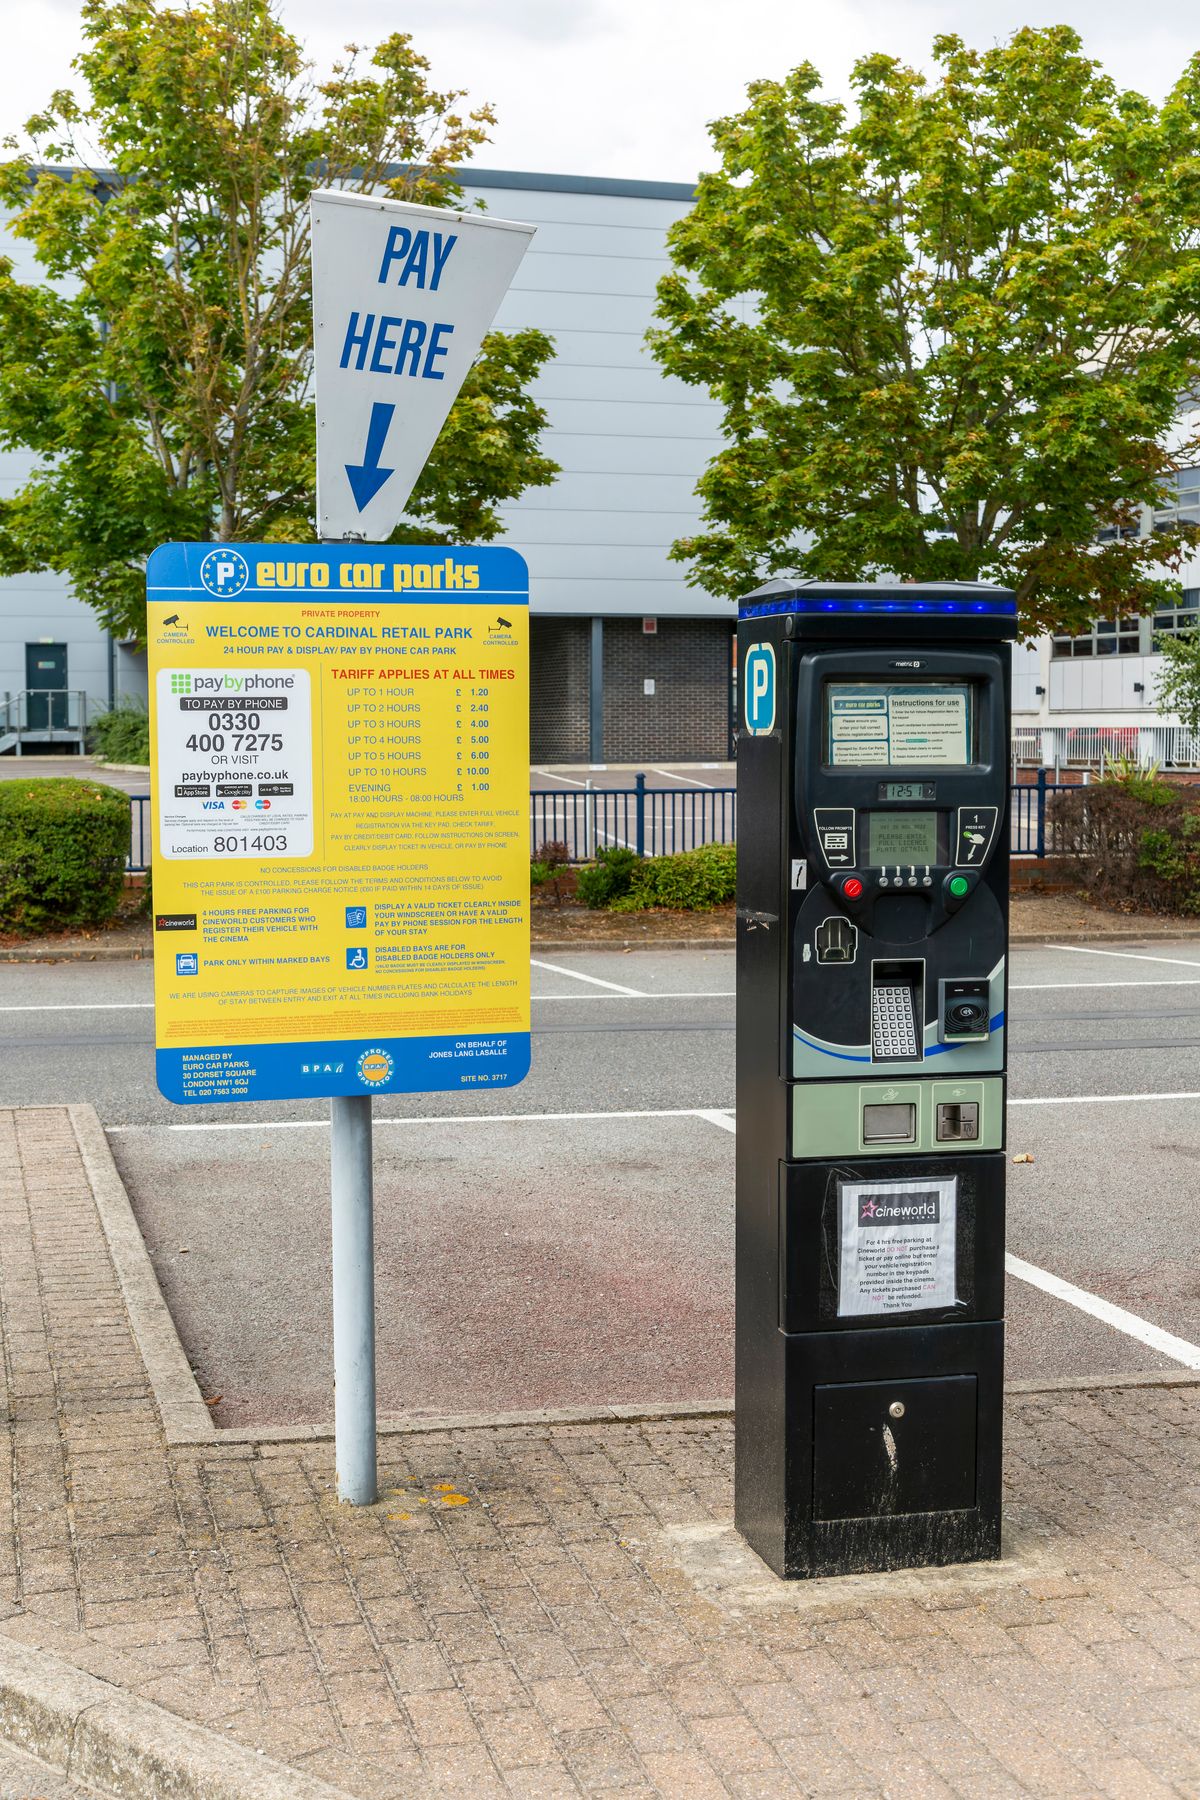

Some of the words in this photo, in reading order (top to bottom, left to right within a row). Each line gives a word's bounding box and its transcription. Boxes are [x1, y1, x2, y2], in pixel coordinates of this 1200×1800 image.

[378, 226, 457, 291] PAY
[340, 312, 454, 380] HERE
[217, 562, 234, 585] P
[256, 562, 329, 587] euro
[339, 563, 385, 588] car
[393, 558, 480, 592] parks
[206, 626, 279, 638] WELCOME
[283, 626, 300, 638] TO
[305, 627, 377, 638] CARDINAL
[382, 628, 430, 638] RETAIL
[435, 628, 472, 638] PARK
[331, 669, 374, 679] TARIFF
[379, 669, 430, 679] APPLIES
[434, 670, 449, 679] AT
[453, 670, 475, 679] ALL
[479, 670, 515, 679] TIMES
[194, 674, 294, 692] paybyphone
[753, 659, 768, 721] P
[186, 700, 200, 708] TO
[203, 700, 224, 708] PAY
[228, 700, 242, 708] BY
[245, 700, 282, 708] PHONE
[209, 713, 260, 731] 0330
[186, 734, 224, 752] 400
[232, 734, 283, 751] 7275
[211, 756, 228, 764] OR
[231, 755, 259, 764] VISIT
[182, 770, 288, 782] paybyphone.co.uk
[891, 785, 922, 797] 12:51
[202, 801, 224, 809] VISA
[974, 815, 979, 823] 1
[214, 835, 287, 852] 801403
[182, 1054, 220, 1062] MANAGED
[357, 1048, 394, 1066] APPROVED
[193, 1071, 224, 1079] DORSET
[226, 1069, 256, 1078] SQUARE
[357, 1070, 394, 1087] OPERATOR
[876, 1202, 935, 1217] cineworld
